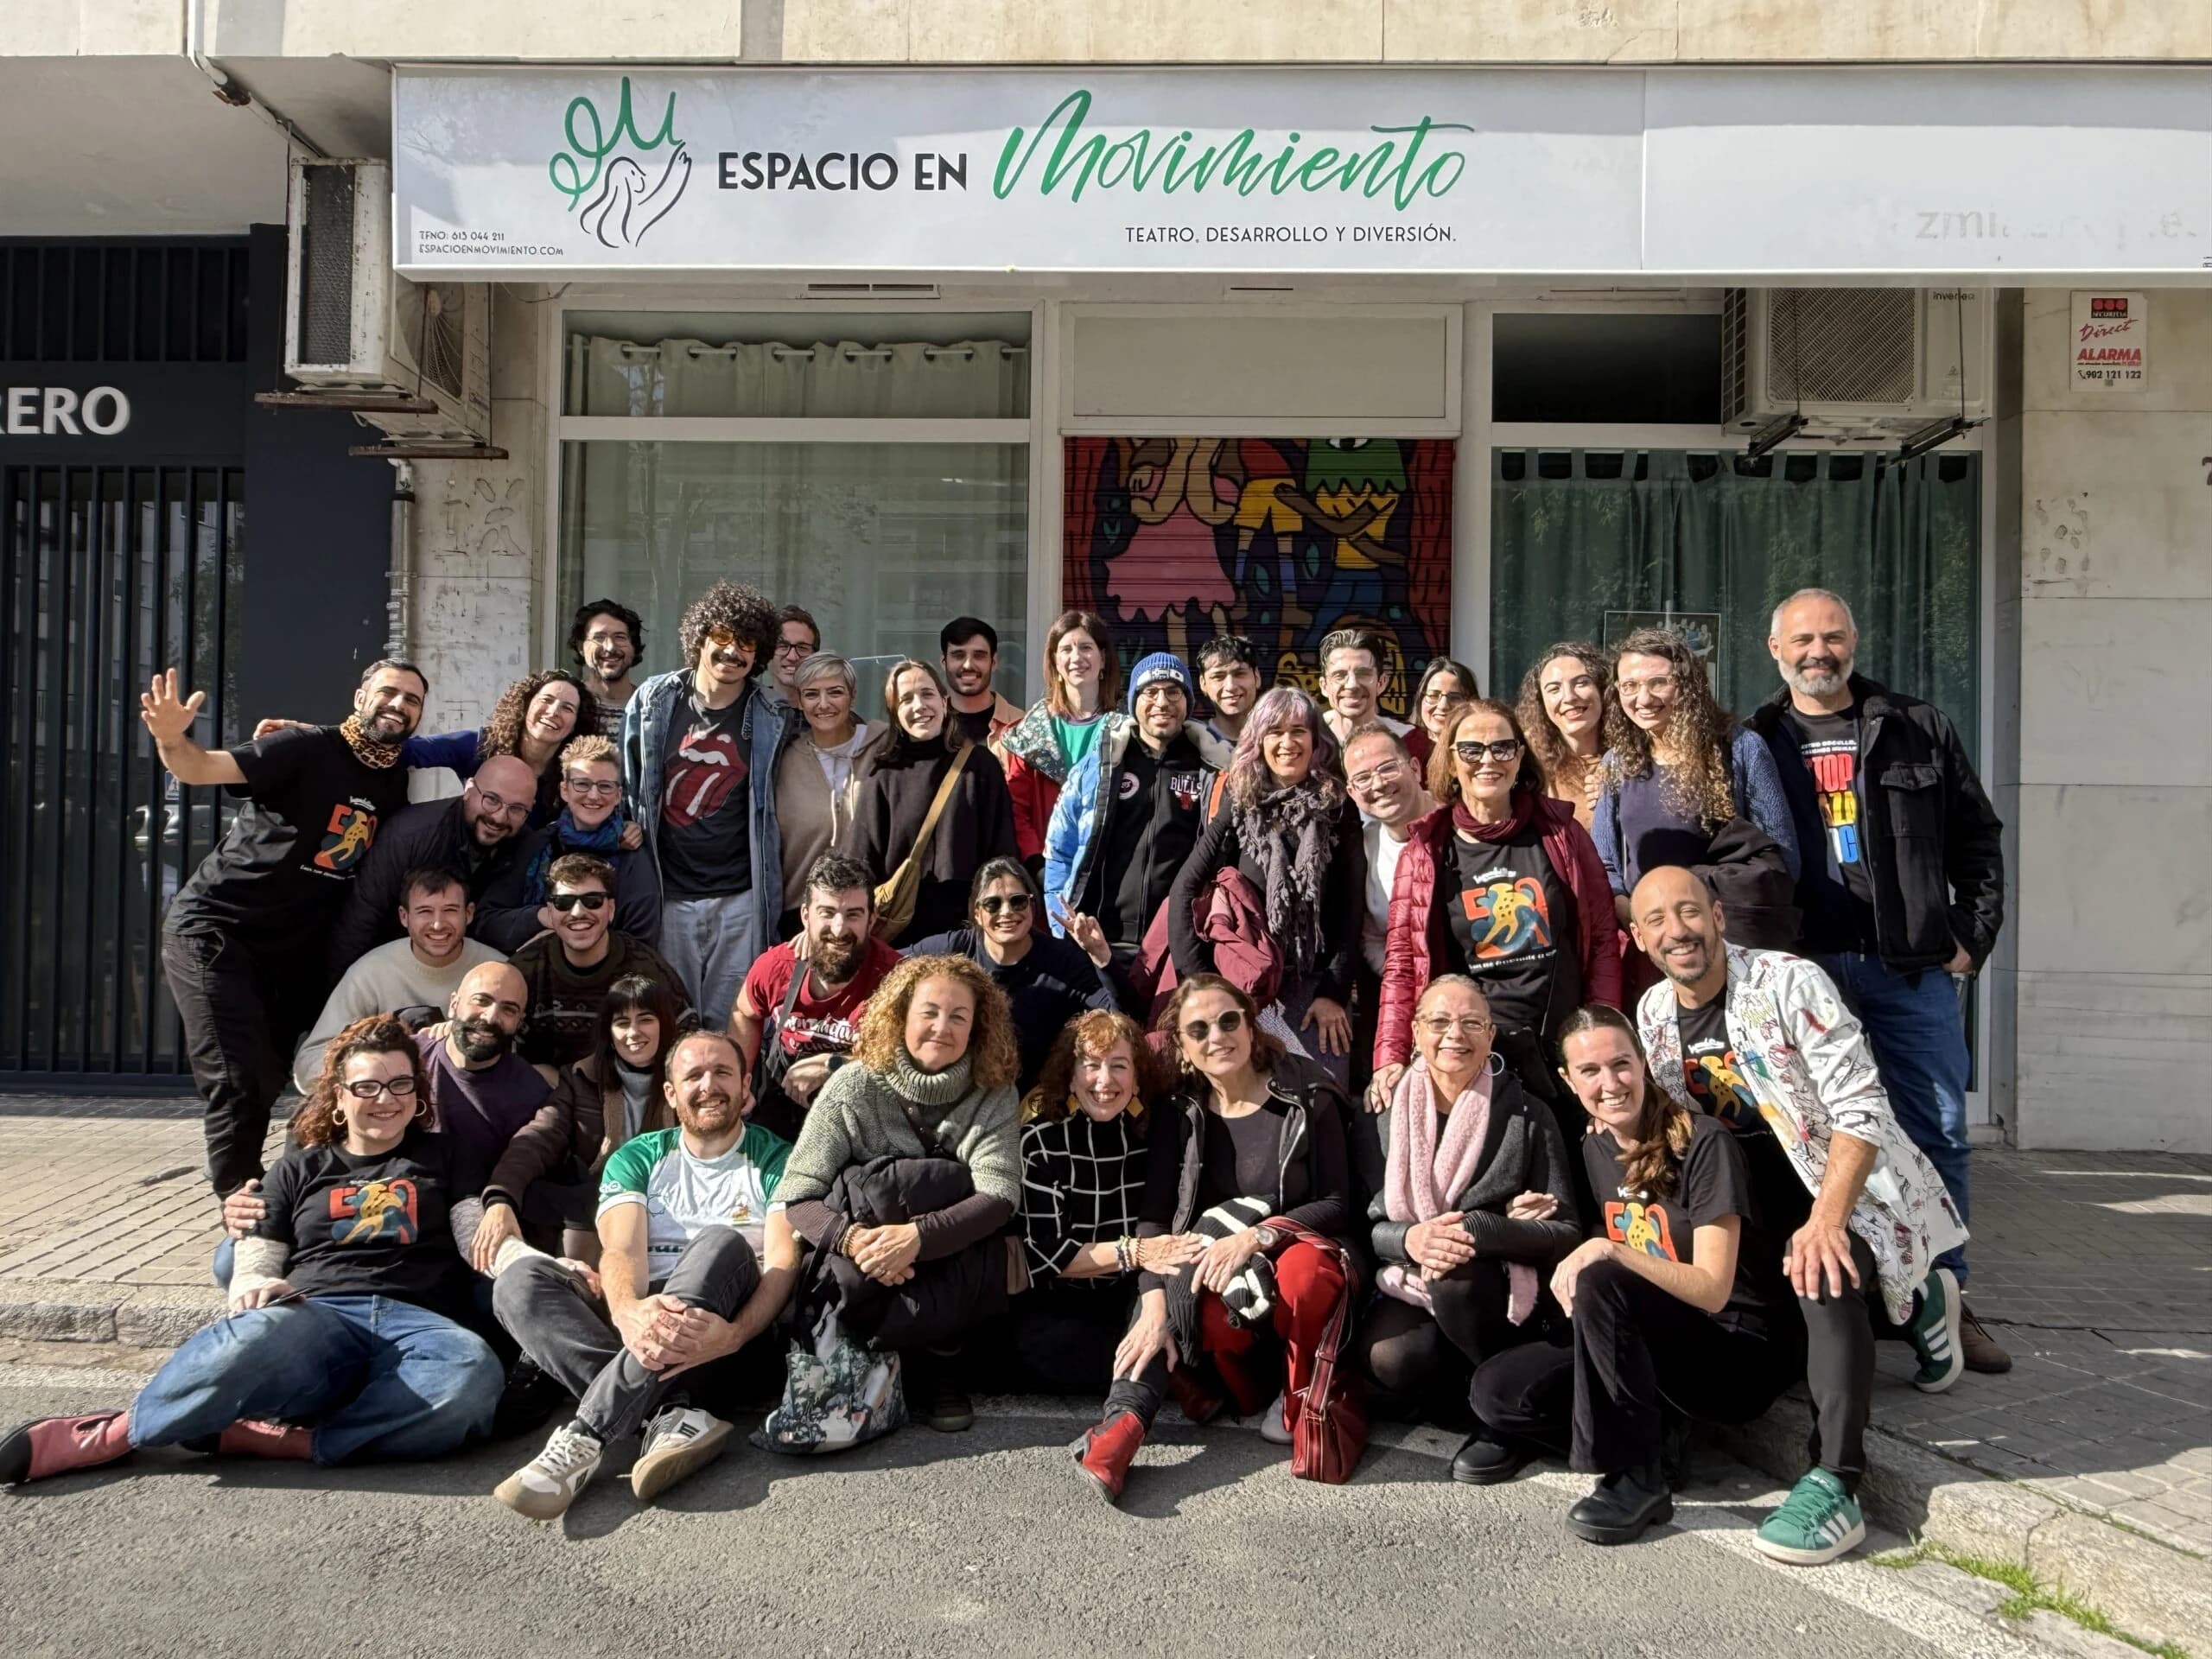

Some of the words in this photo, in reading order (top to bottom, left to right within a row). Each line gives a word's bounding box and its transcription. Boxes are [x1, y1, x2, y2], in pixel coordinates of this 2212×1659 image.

[718, 151, 899, 191] ESPACIO
[914, 153, 967, 191] EN
[993, 89, 1475, 212] Movimiento
[470, 231, 489, 241] 044
[492, 232, 505, 241] 211
[1125, 226, 1200, 244] TEATRO,
[1205, 226, 1328, 243] DESARROLLO
[1335, 226, 1346, 242] Y
[1352, 222, 1457, 243] DIVERSIÓN.
[419, 244, 564, 257] ESPACIOENMOVIMIENTO.COM
[2079, 319, 2139, 342] Direct
[2077, 347, 2142, 361] ALARMA
[2086, 370, 2103, 379] 902
[2106, 370, 2121, 379] 121
[0, 385, 130, 435] ERO
